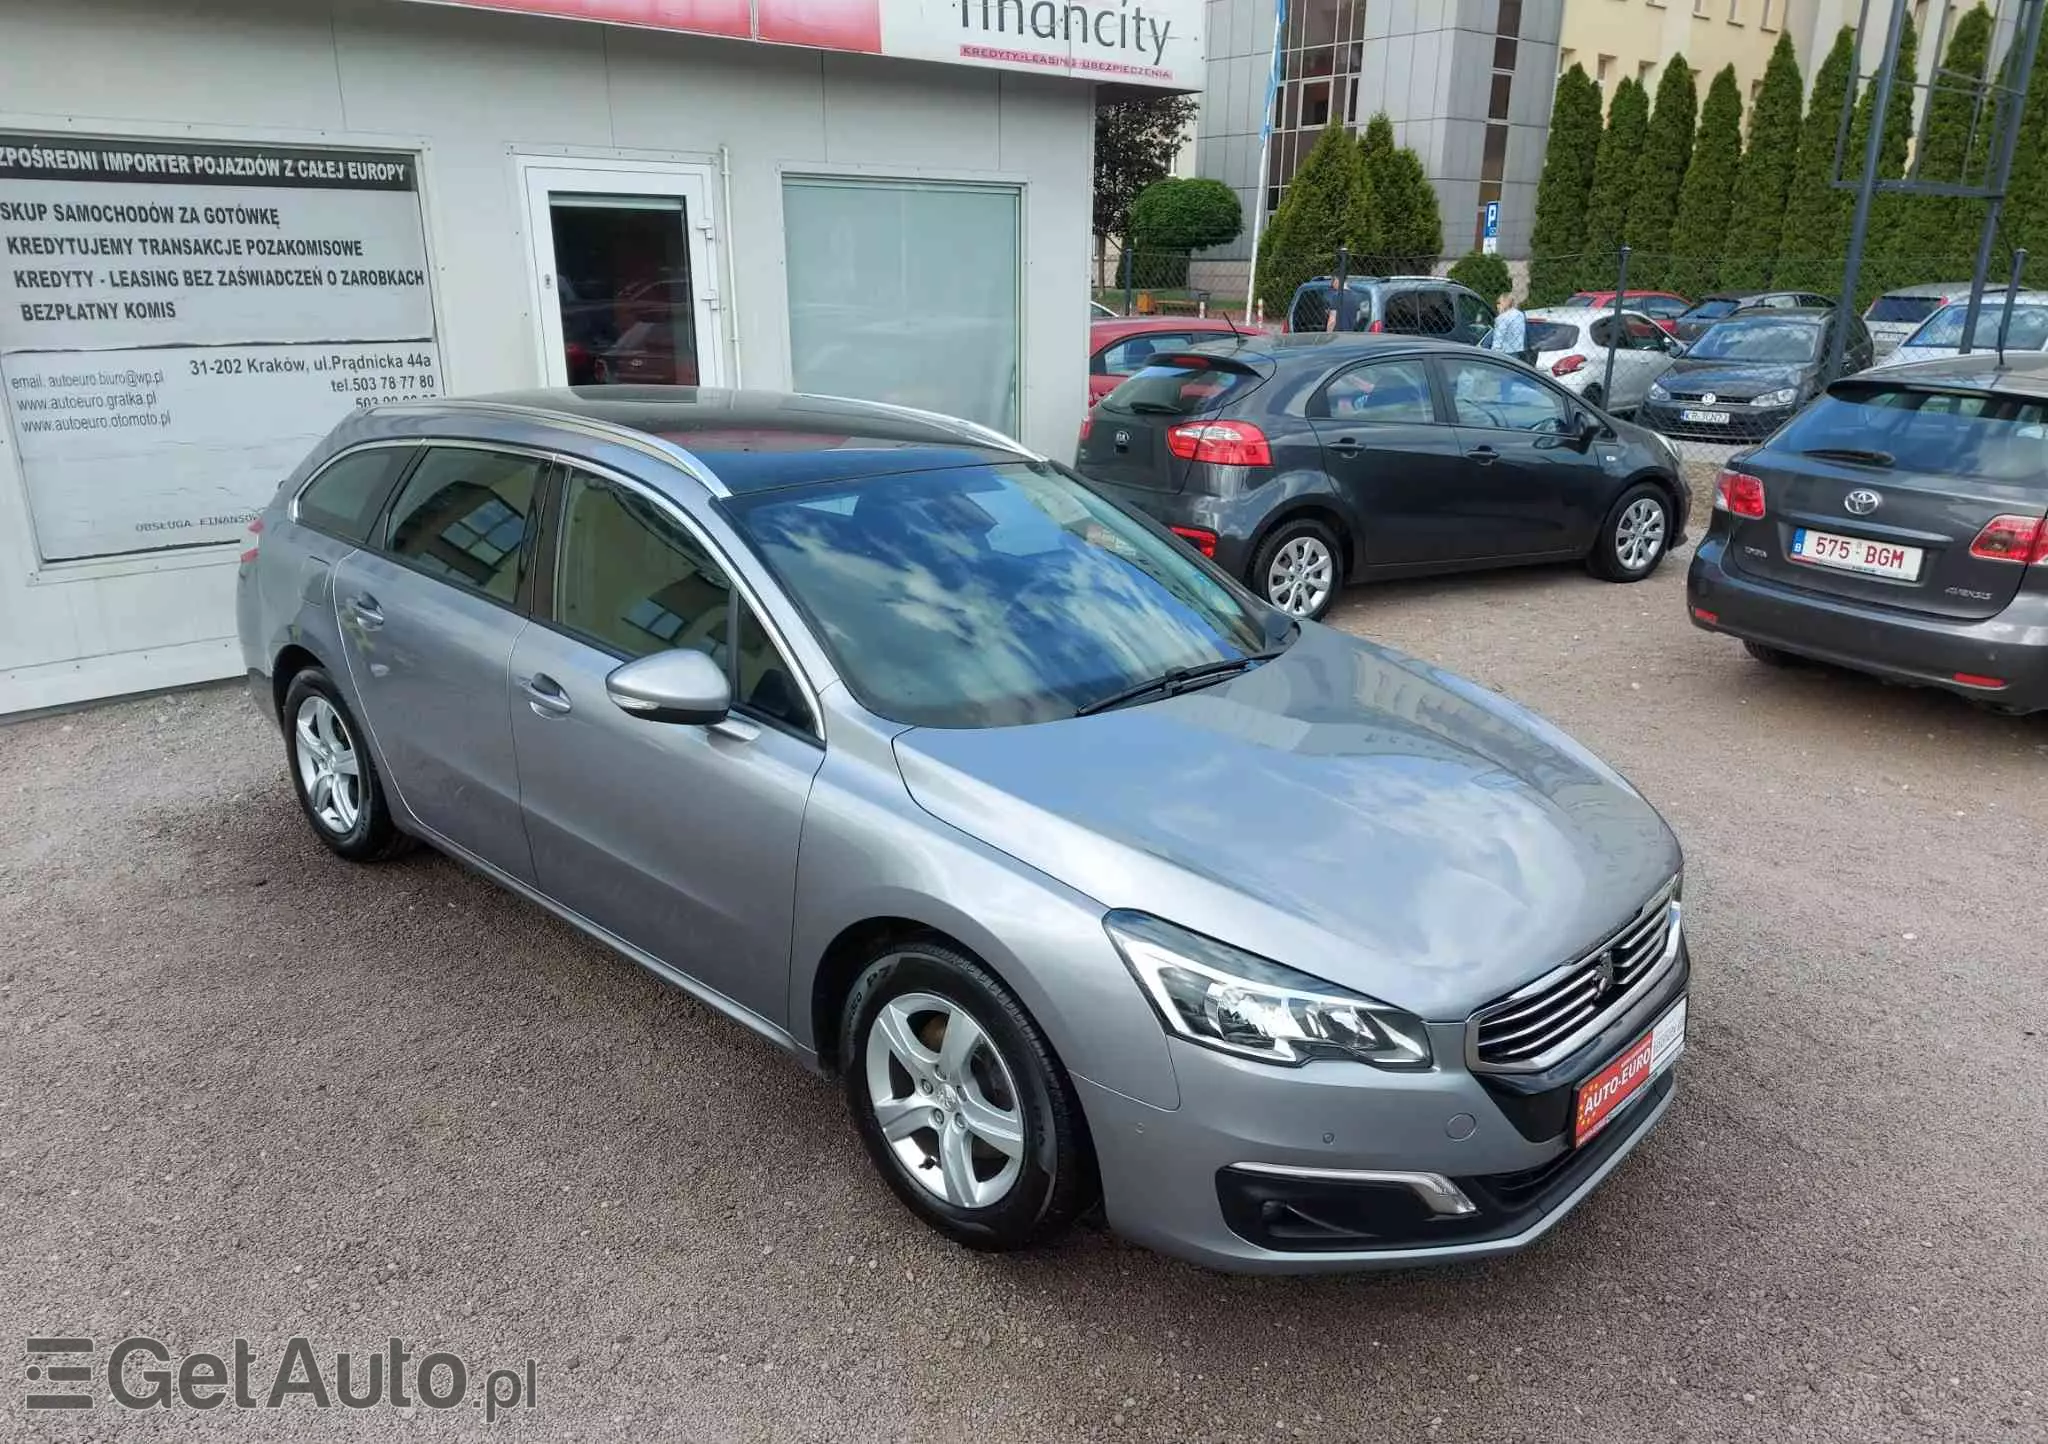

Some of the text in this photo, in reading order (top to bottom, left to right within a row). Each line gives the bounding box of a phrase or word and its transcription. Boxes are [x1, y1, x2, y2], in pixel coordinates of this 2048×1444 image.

[103, 151, 191, 174] IMPORTER
[194, 154, 280, 177] POJAZDÓW
[284, 159, 295, 177] Z
[298, 159, 344, 179] CAŁEJ
[348, 162, 405, 181] EUROPY
[0, 201, 280, 229] SKUP SAMOCHODÓW ZA GOTÓWKĘ
[6, 236, 364, 257] KREDYTUJEMY TRANSAKCJE POZAKOMISOWE
[14, 270, 94, 289] KREDYTY
[109, 269, 179, 288] LEASING
[183, 269, 214, 288] BEZ
[217, 265, 323, 287] ZAŚWIADCZEŃ
[327, 270, 337, 287] O
[341, 268, 425, 287] ZAROBKACH
[21, 301, 177, 321] BEZPŁATNY KOMIS
[189, 353, 431, 376] 31-202 Kraków, ul.Prądnicka 44a
[331, 374, 434, 392] tel.503 78 77 80
[18, 390, 157, 411] www.autoeuro.gratka.pl
[21, 410, 171, 433] www.autoeuro.otomoto.pl
[1864, 545, 1905, 569] BGM
[1584, 1047, 1650, 1116] AUTO-EURO
